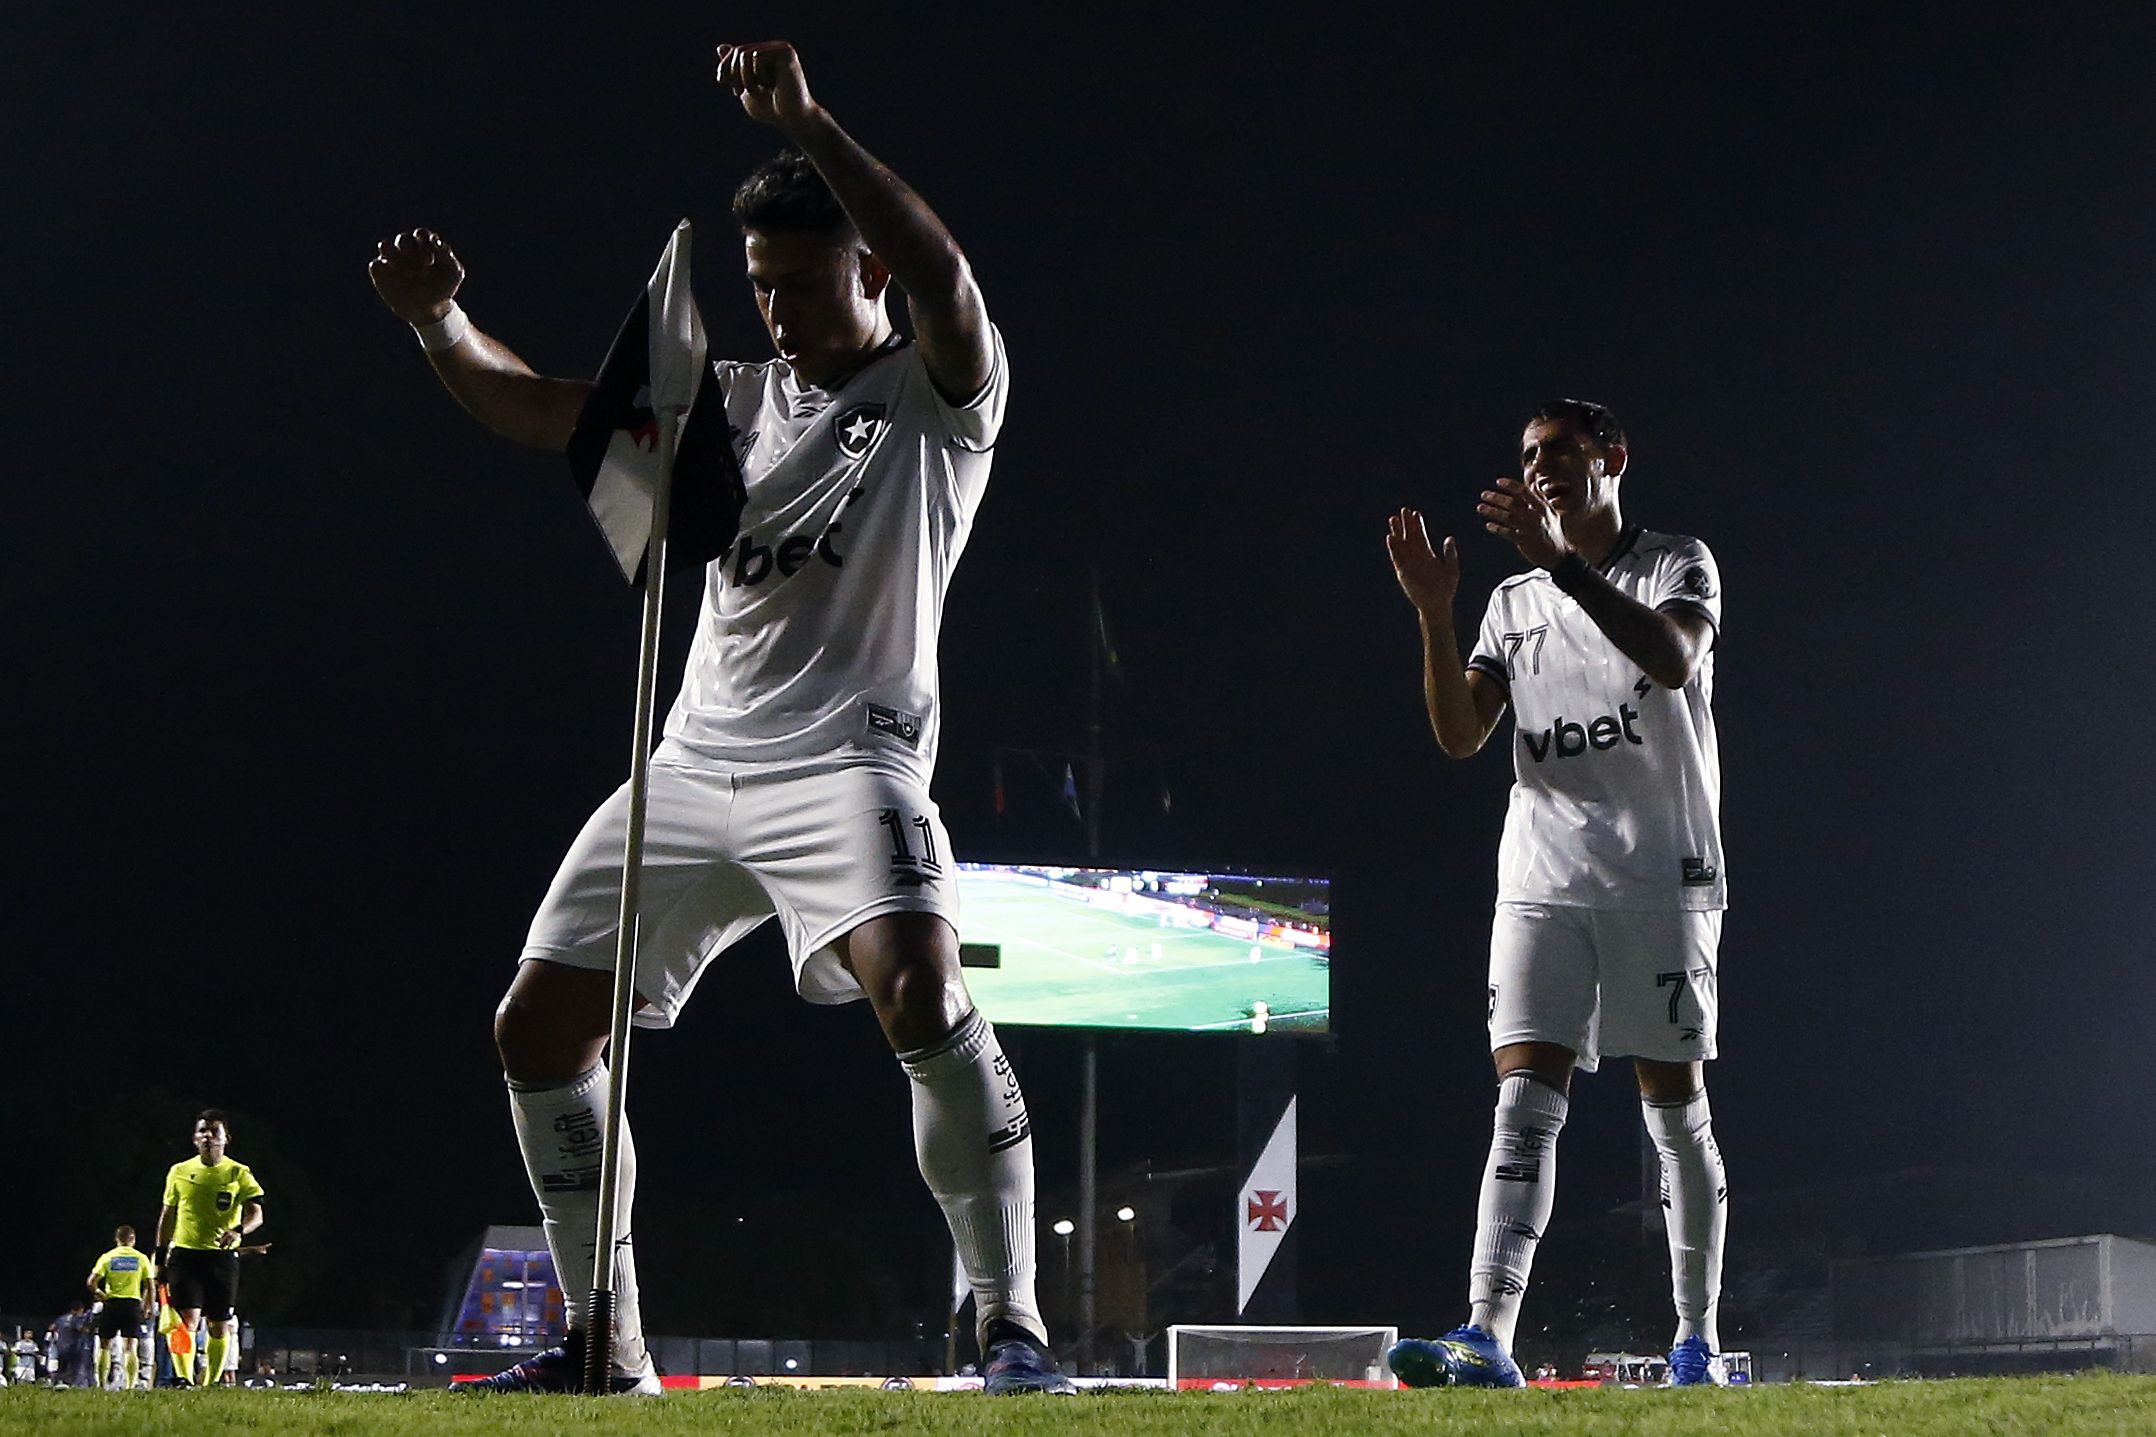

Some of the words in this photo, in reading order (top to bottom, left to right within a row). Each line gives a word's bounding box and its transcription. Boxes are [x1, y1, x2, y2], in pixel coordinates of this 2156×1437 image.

[719, 521, 844, 588] bet
[1503, 622, 1549, 681] 77
[1523, 702, 1643, 763] vbet
[879, 808, 942, 875] 11
